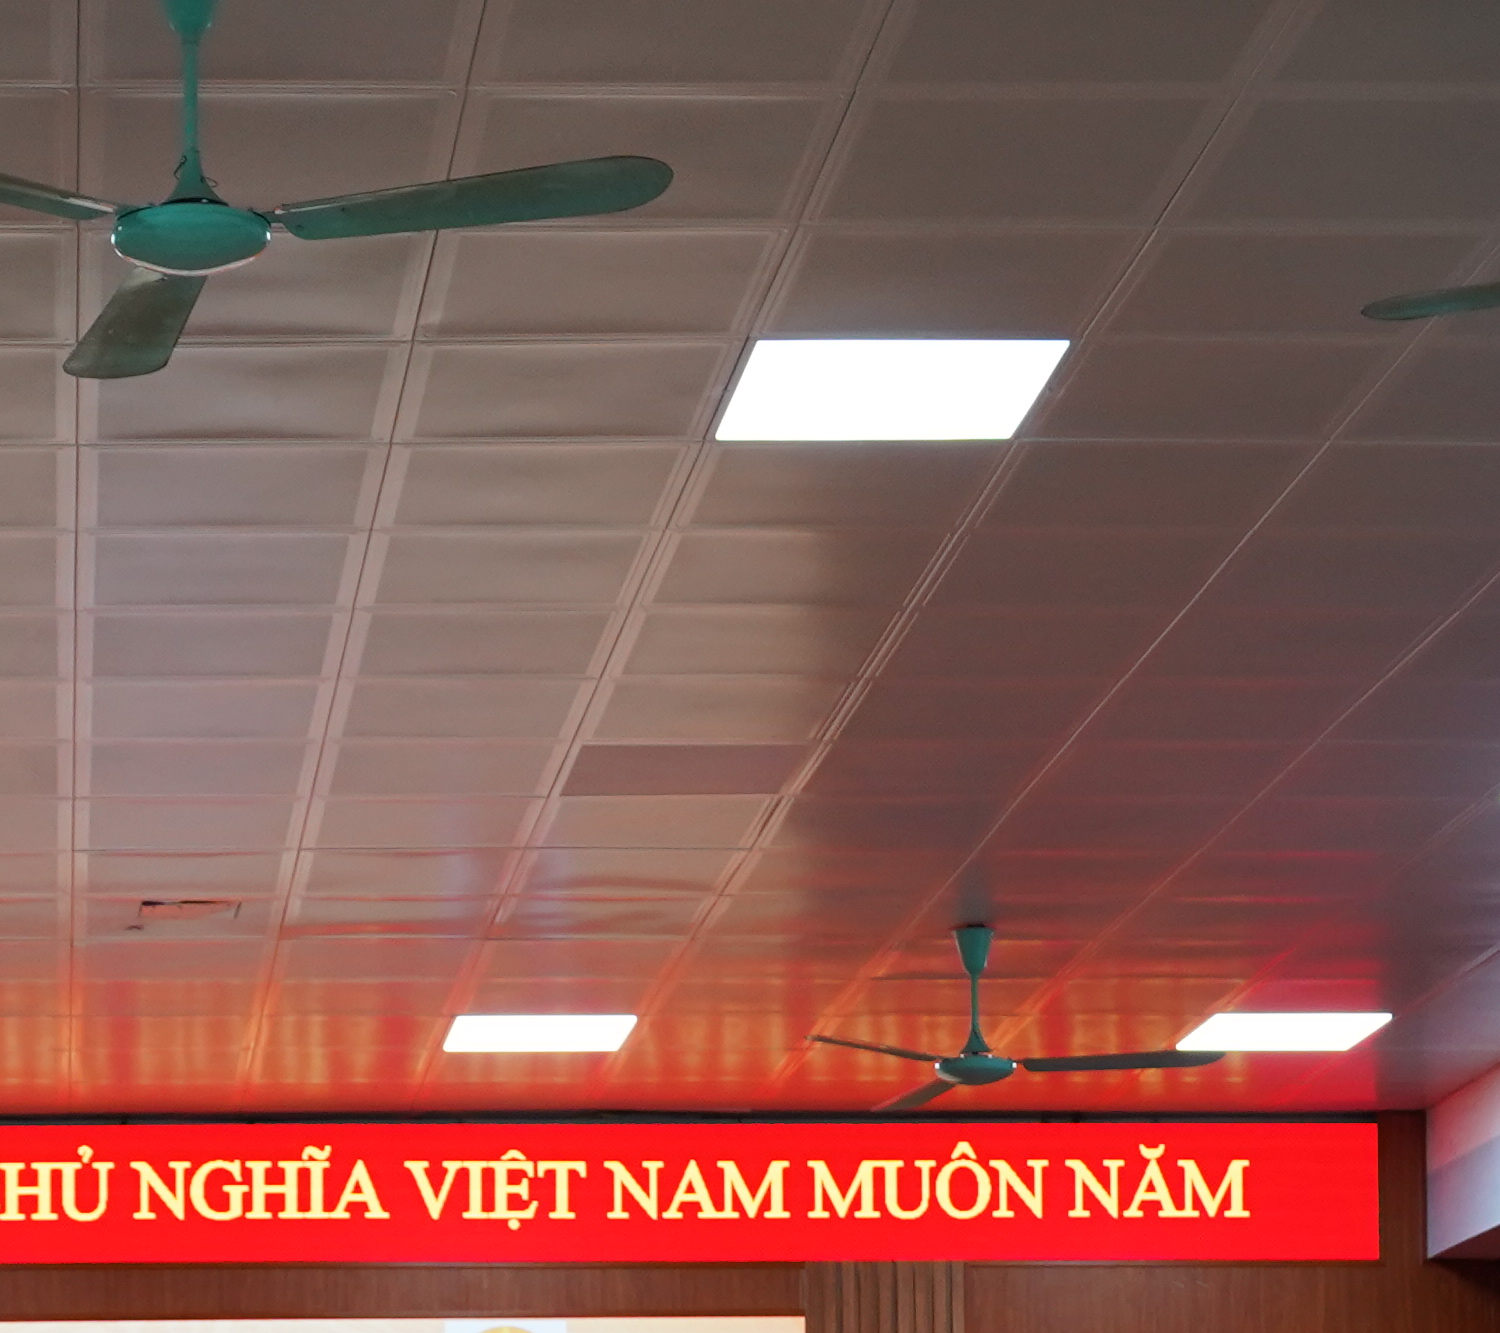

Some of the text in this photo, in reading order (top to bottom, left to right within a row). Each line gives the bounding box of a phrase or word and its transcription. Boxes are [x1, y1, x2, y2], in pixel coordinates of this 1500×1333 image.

[130, 1145, 390, 1220] NGHĨA
[404, 1150, 586, 1230] VIỆT
[604, 1160, 790, 1220] NAM
[807, 1141, 1049, 1219] MUÔN
[1065, 1144, 1250, 1218] NĂM
